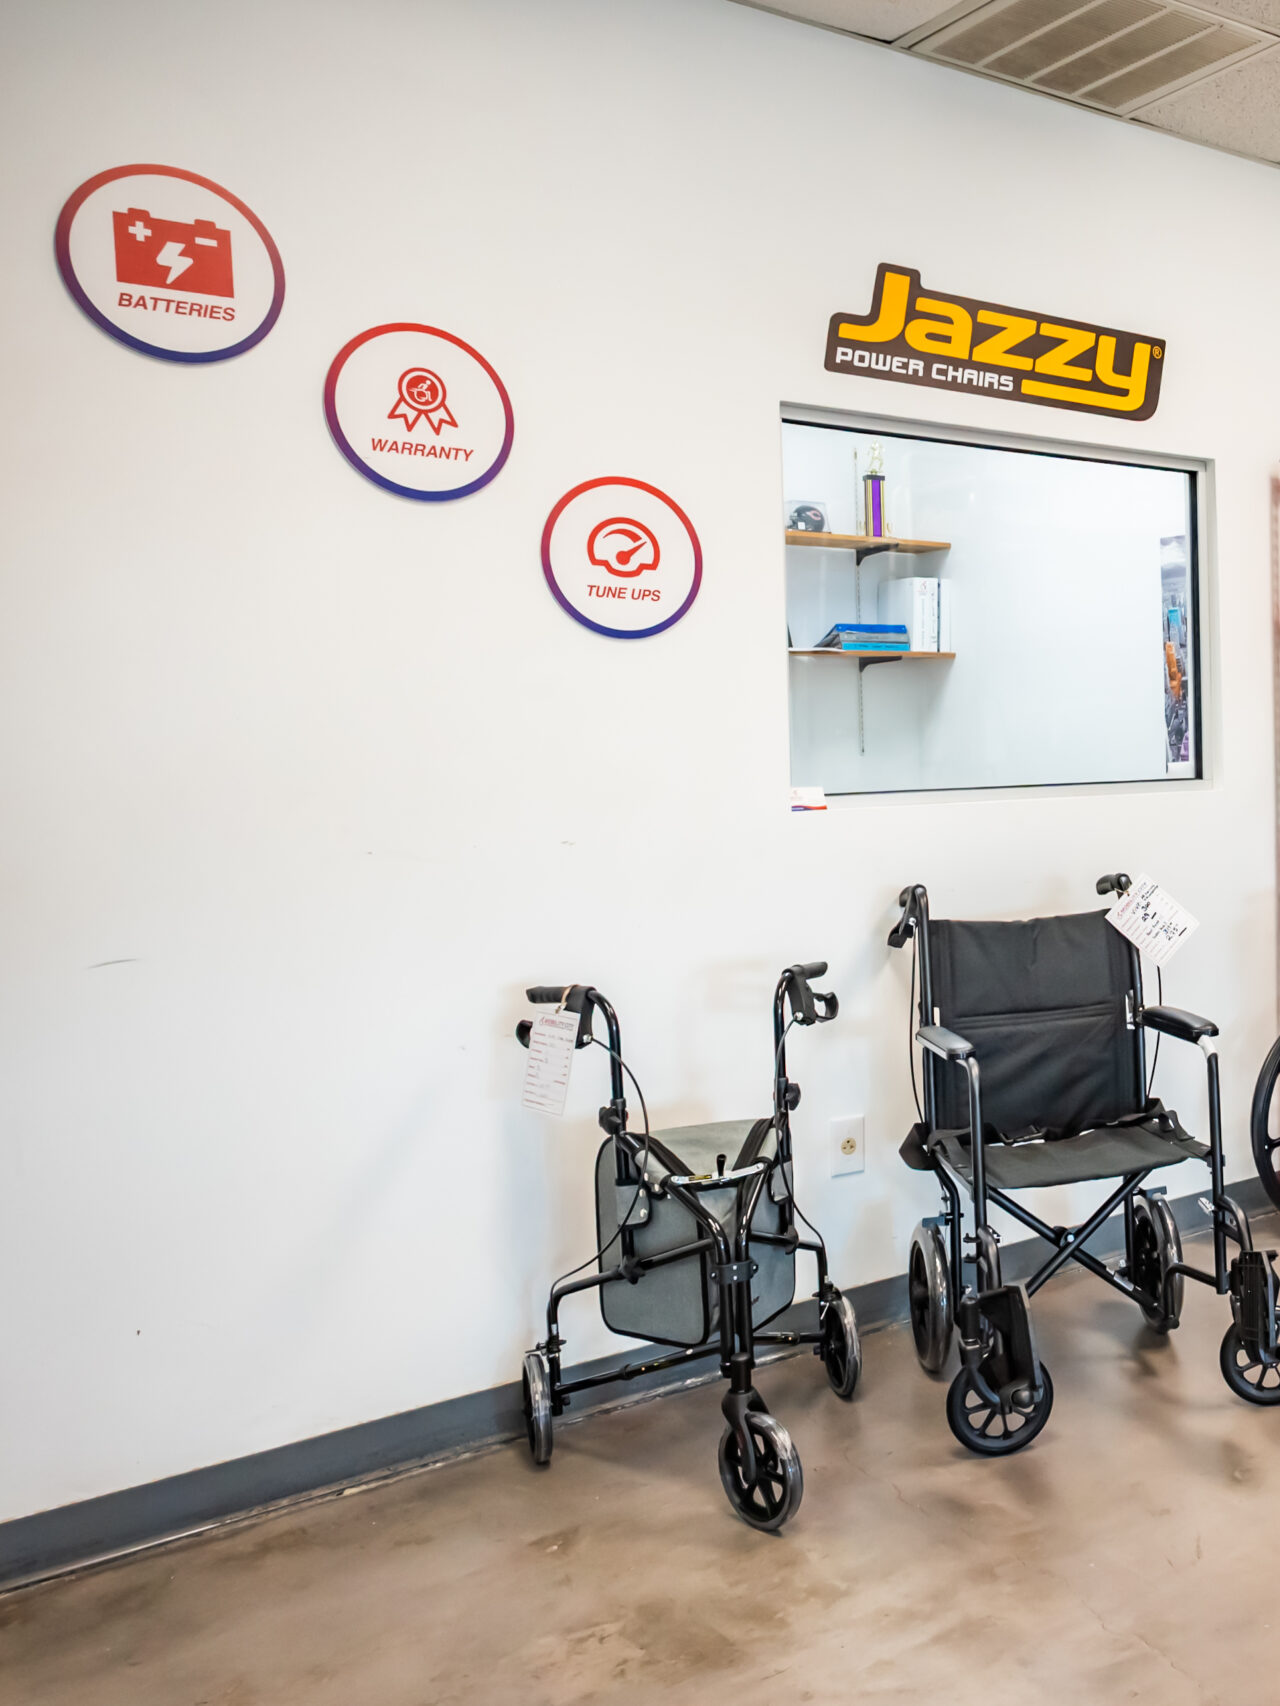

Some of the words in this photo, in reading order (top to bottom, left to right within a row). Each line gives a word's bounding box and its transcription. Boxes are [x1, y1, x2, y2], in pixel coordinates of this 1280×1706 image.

[118, 293, 236, 321] BATTERIES
[836, 347, 924, 376] POWER
[931, 363, 1014, 391] CHAIRS
[371, 438, 474, 462] WARRANTY
[587, 585, 628, 600] TUNE
[631, 588, 661, 602] UPS
